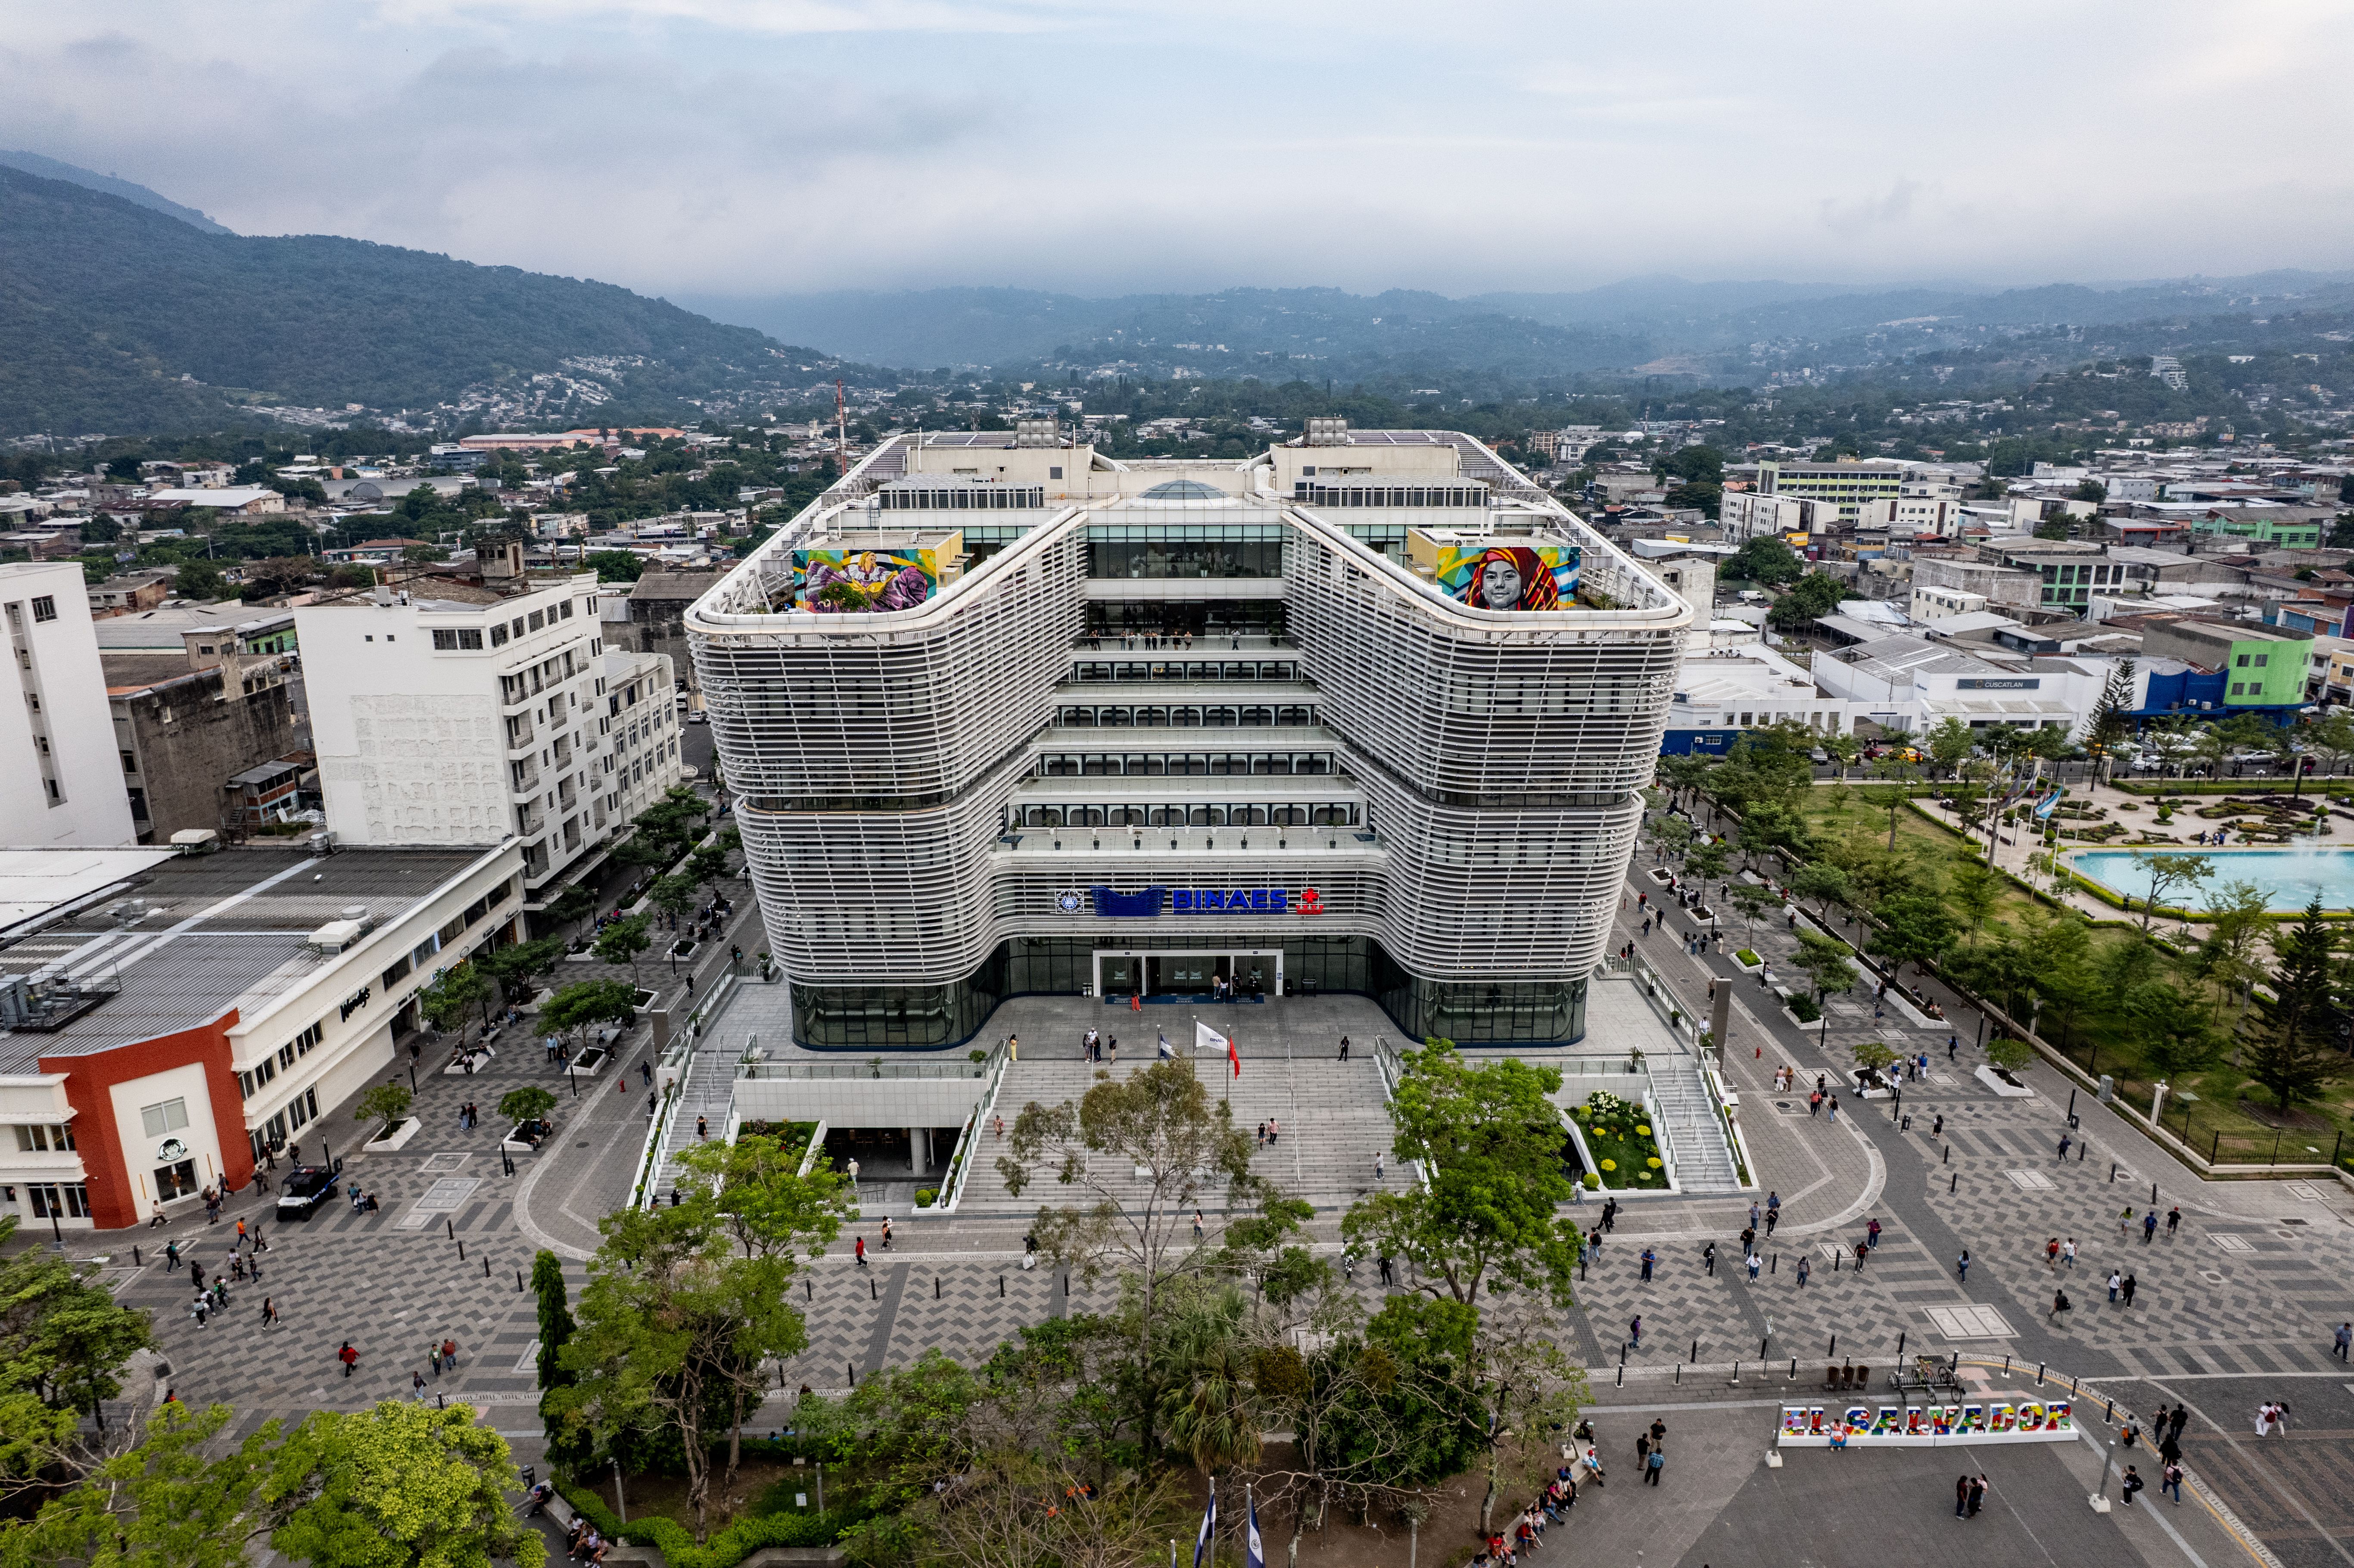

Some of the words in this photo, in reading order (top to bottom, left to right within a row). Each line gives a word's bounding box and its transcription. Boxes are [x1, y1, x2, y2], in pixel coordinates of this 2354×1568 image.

[1173, 889, 1288, 909] BINAES
[339, 986, 371, 1023] Wendy's
[1782, 1406, 1831, 1436] EL
[1844, 1400, 2072, 1436] SALVADOR
